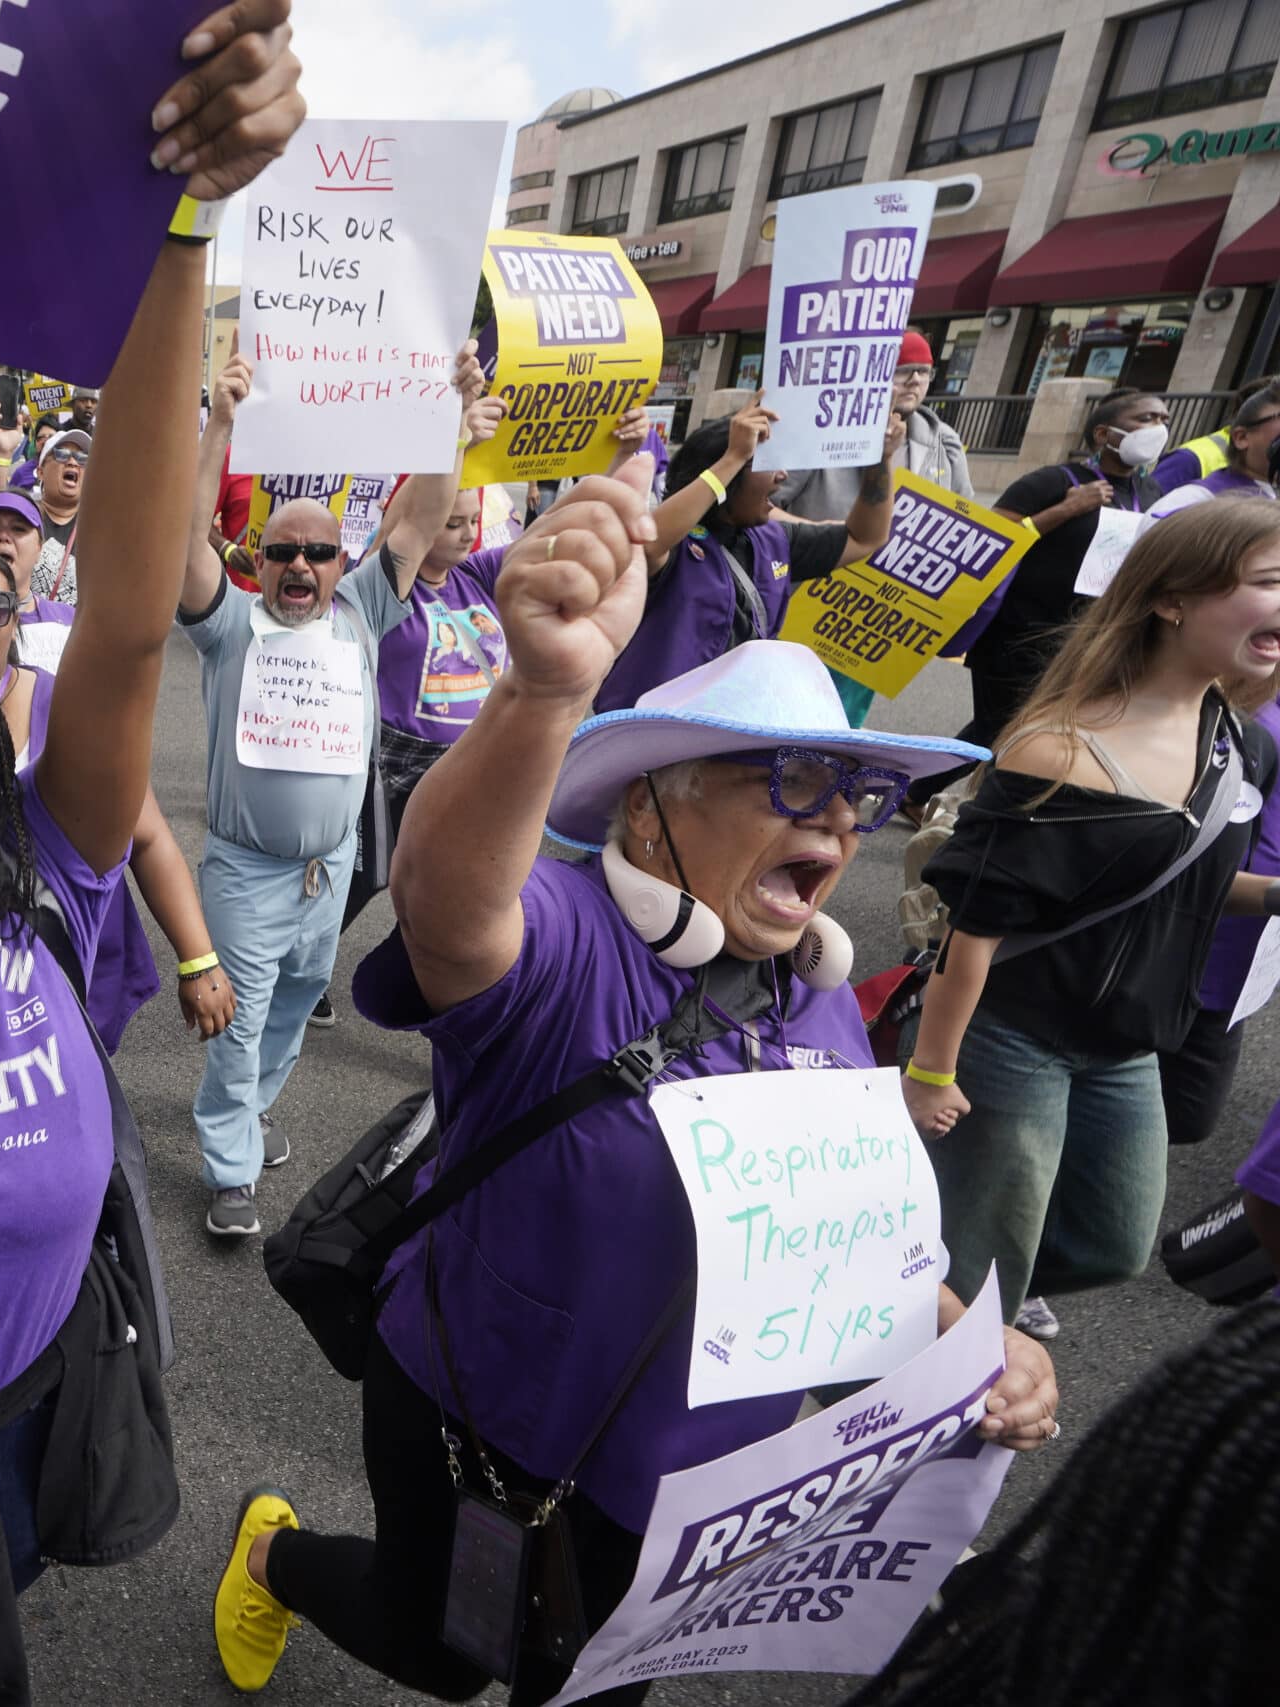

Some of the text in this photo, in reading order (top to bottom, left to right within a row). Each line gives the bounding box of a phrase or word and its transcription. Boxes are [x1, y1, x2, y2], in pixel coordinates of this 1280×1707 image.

[316, 135, 397, 183] WE
[1171, 122, 1280, 165] QUIZ
[257, 205, 395, 244] RISK OUR
[298, 254, 361, 281] LIVES
[623, 246, 648, 261] ffee
[657, 241, 679, 256] tea
[850, 237, 912, 283] OUR
[498, 251, 624, 292] PATIENT
[538, 294, 621, 341] NEED
[797, 287, 914, 335] PATIENT
[255, 332, 303, 361] HOW
[314, 345, 367, 363] MUCH
[409, 352, 452, 369] THAT
[566, 353, 597, 376] NOT
[778, 342, 902, 388] NEED MO
[29, 385, 64, 400] PATIENT
[38, 399, 62, 412] NEED
[500, 378, 649, 422] CORPORATE
[815, 387, 888, 428] STAFF
[507, 419, 598, 458] GREED
[512, 459, 535, 470] LABOR
[536, 459, 549, 468] DAY
[350, 479, 382, 498] PECT
[343, 499, 368, 518] LUE
[892, 494, 1006, 571] PATIENT
[874, 535, 956, 594] NEED
[876, 581, 908, 604] NOT
[807, 574, 943, 656] CORPORATE
[812, 611, 892, 664] GREED
[689, 1118, 911, 1198] Respiratory
[727, 1196, 918, 1281] Therapist
[910, 1242, 924, 1261] AM
[900, 1255, 936, 1280] COOL
[703, 1340, 732, 1365] COOL
[833, 1400, 892, 1437] SEIU-
[842, 1407, 904, 1446] UHW
[724, 1540, 933, 1599] HCARE
[620, 1644, 749, 1676] LABOR DAY 2023
[631, 1657, 721, 1677] #UNITED4ALL
